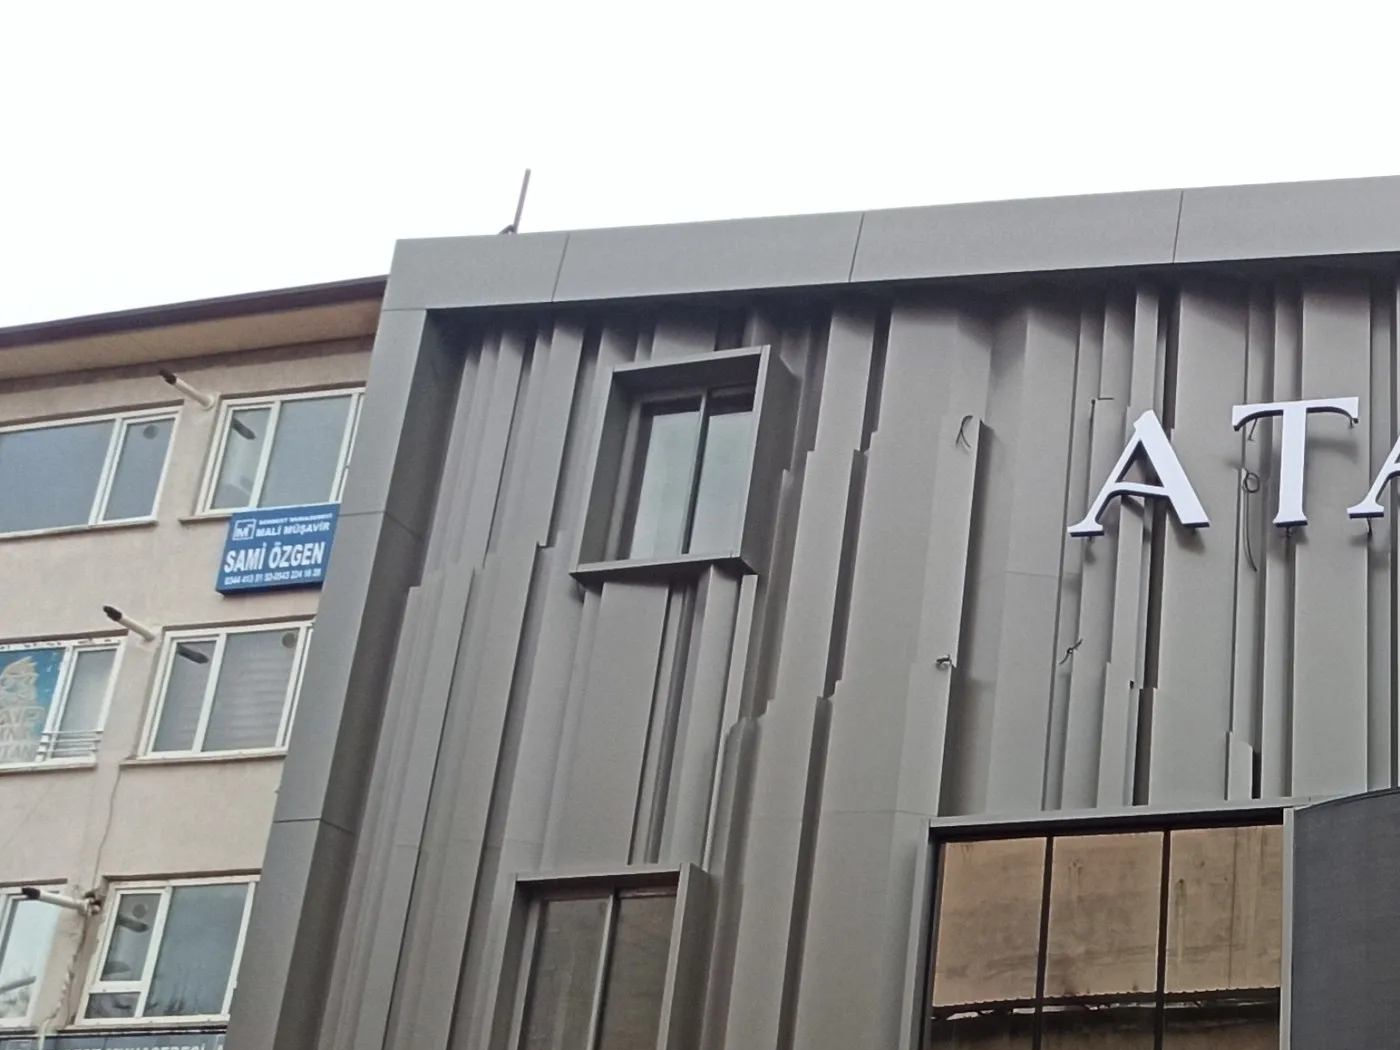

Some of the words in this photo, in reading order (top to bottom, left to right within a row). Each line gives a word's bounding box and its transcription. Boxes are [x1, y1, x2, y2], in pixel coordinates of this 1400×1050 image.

[255, 524, 281, 537] MALİ
[283, 521, 330, 536] MÜŞAVİR
[223, 542, 267, 573] SAMİ
[268, 541, 326, 569] ÖZGEN
